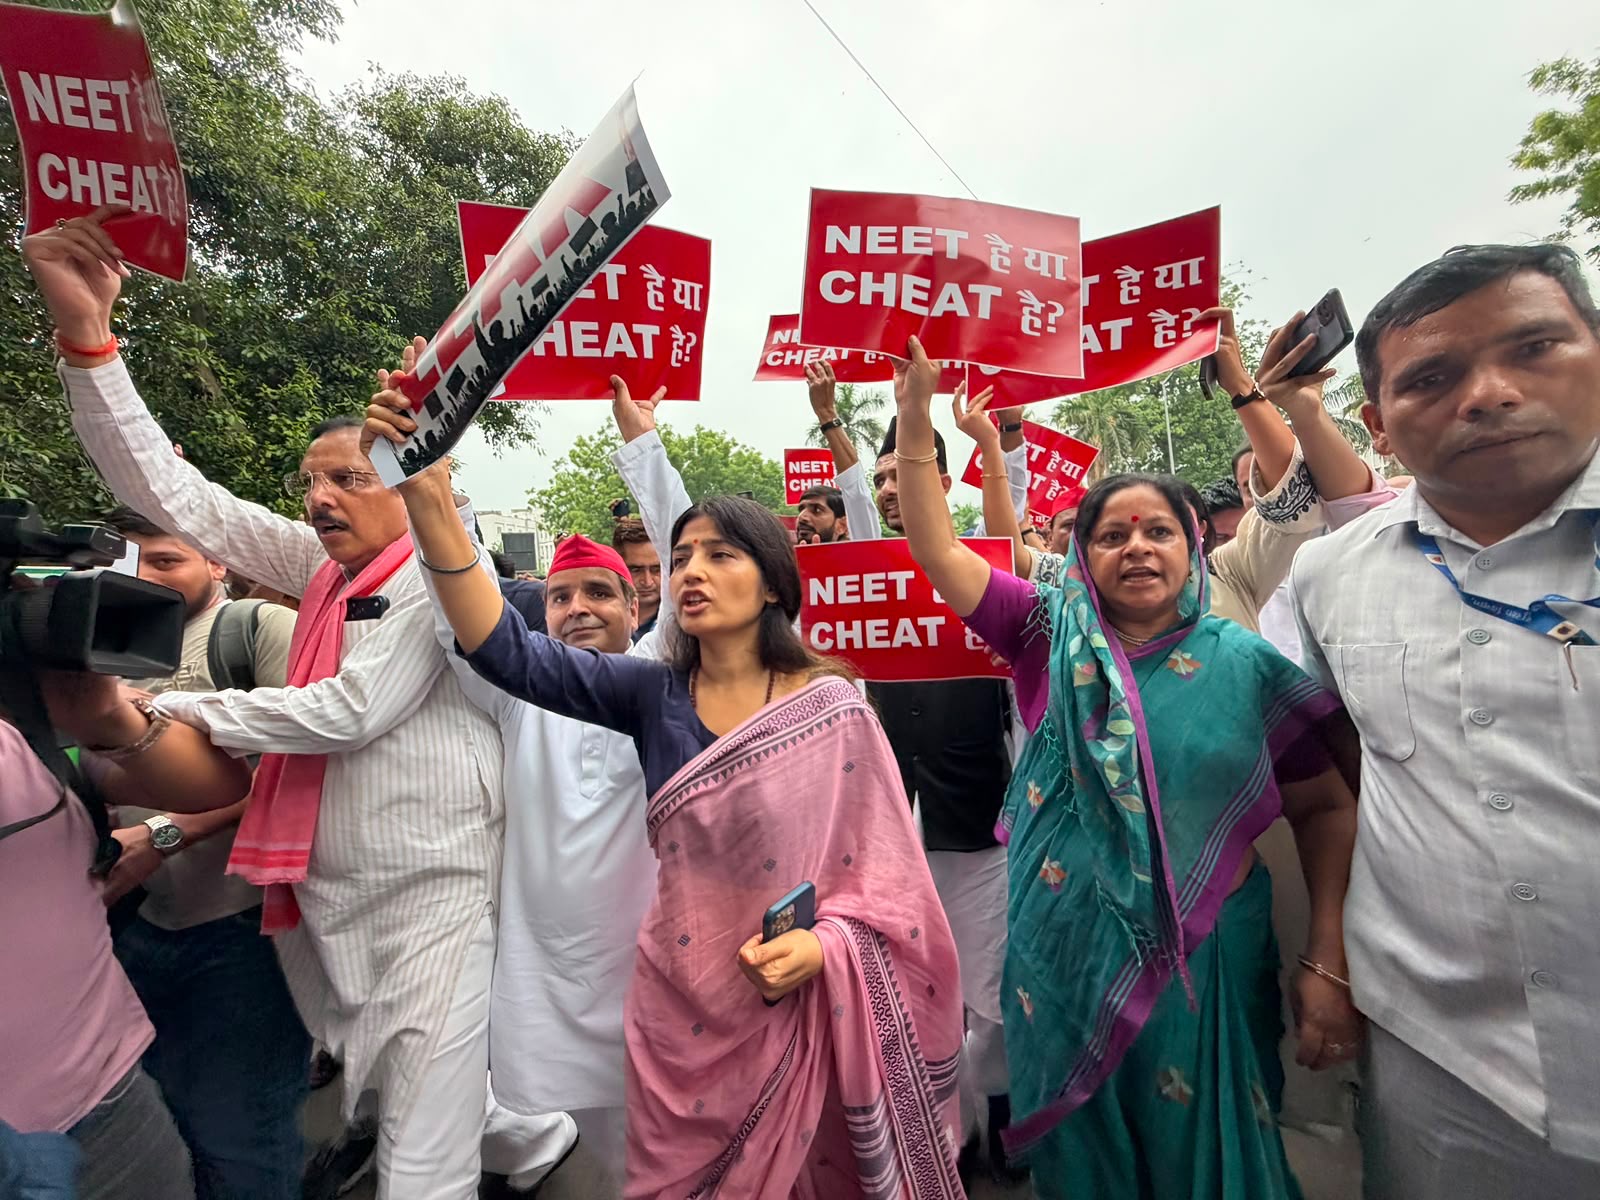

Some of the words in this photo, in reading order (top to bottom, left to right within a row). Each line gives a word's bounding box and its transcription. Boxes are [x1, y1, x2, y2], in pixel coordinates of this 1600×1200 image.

[18, 71, 133, 133] NEET
[38, 152, 163, 216] CHEAT
[825, 225, 968, 259] NEET
[984, 233, 1013, 274] है
[1022, 247, 1069, 281] या
[639, 264, 666, 311] है
[671, 278, 703, 311] या
[819, 270, 1002, 319] CHEAT
[1015, 289, 1065, 337] है?
[1113, 265, 1145, 305] है
[1153, 256, 1205, 290] या
[532, 320, 661, 359] HEAT
[669, 324, 697, 367] है?
[1147, 308, 1201, 349] है?
[789, 461, 829, 474] NEET
[1061, 459, 1084, 480] या
[809, 570, 915, 606] NEET
[810, 616, 945, 651] CHEAT
